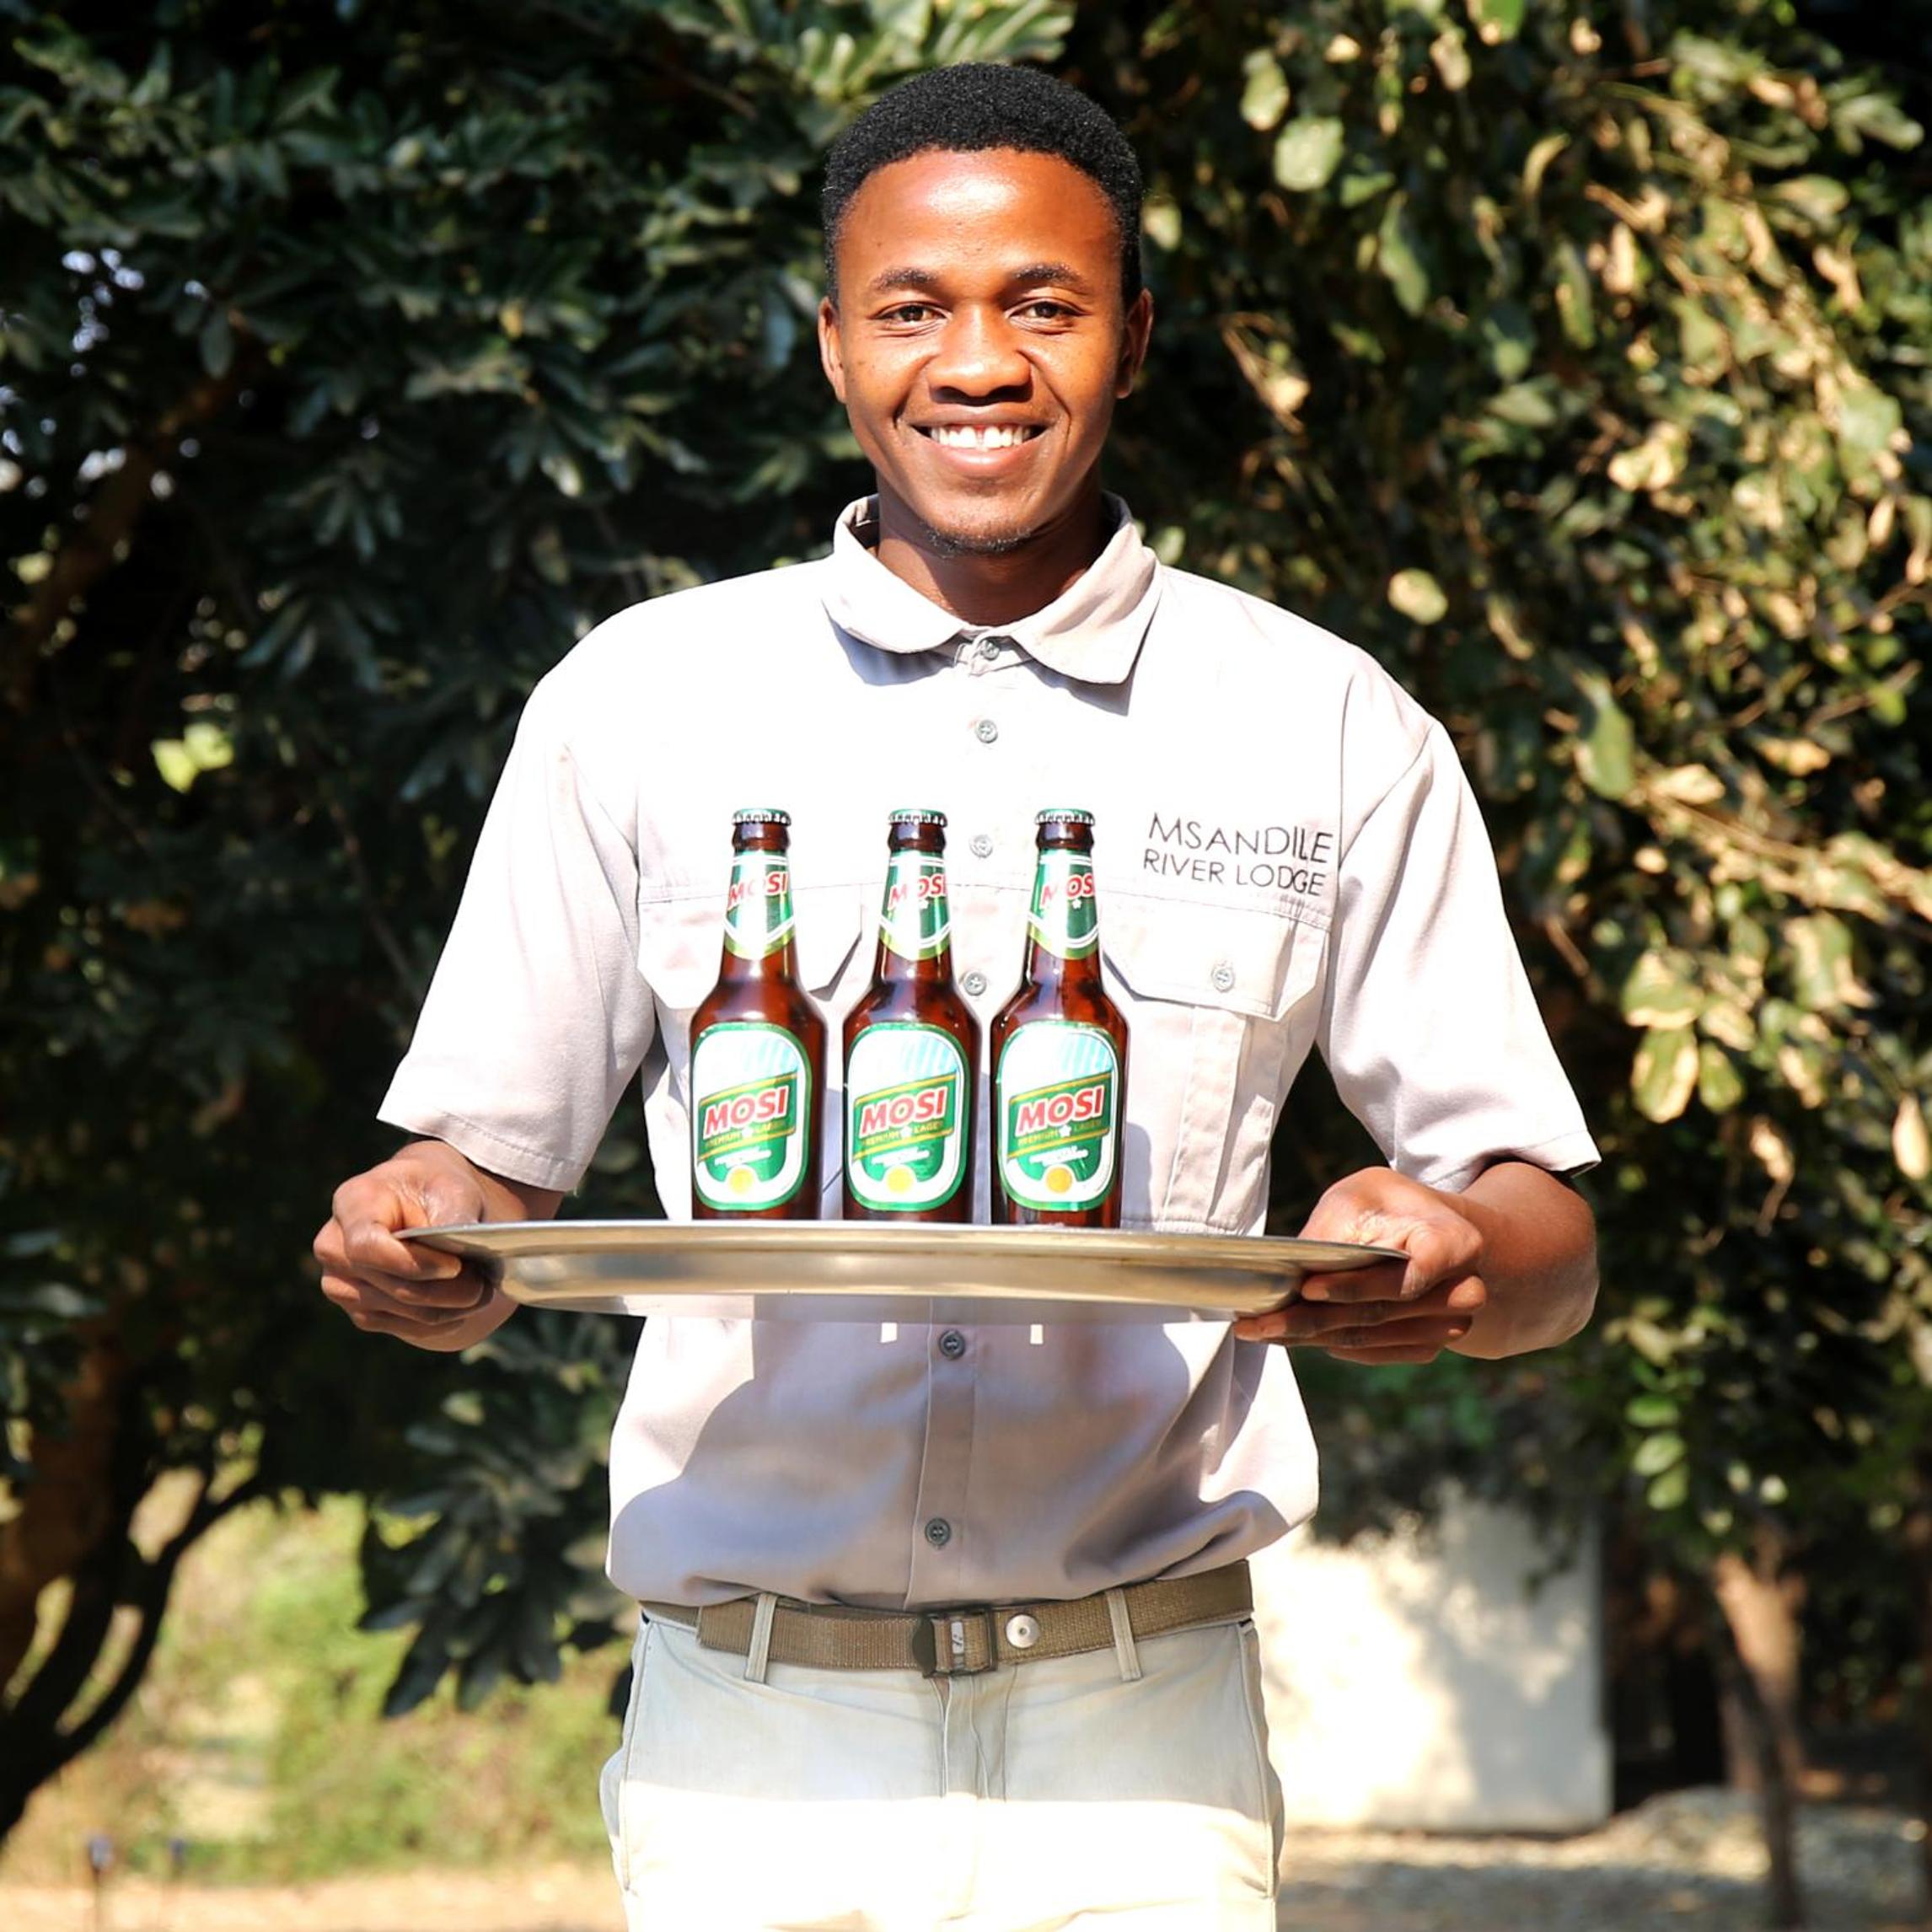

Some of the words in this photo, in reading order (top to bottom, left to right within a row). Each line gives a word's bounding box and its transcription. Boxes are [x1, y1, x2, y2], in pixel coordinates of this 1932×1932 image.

[1148, 812, 1334, 864] MSANDILE
[1040, 872, 1093, 907] MOS
[1143, 848, 1225, 884] RIVER
[1236, 864, 1327, 897] LODGE
[705, 1087, 788, 1138] MOSI
[860, 1087, 947, 1137] MOSI
[1016, 1086, 1103, 1136] MOSI
